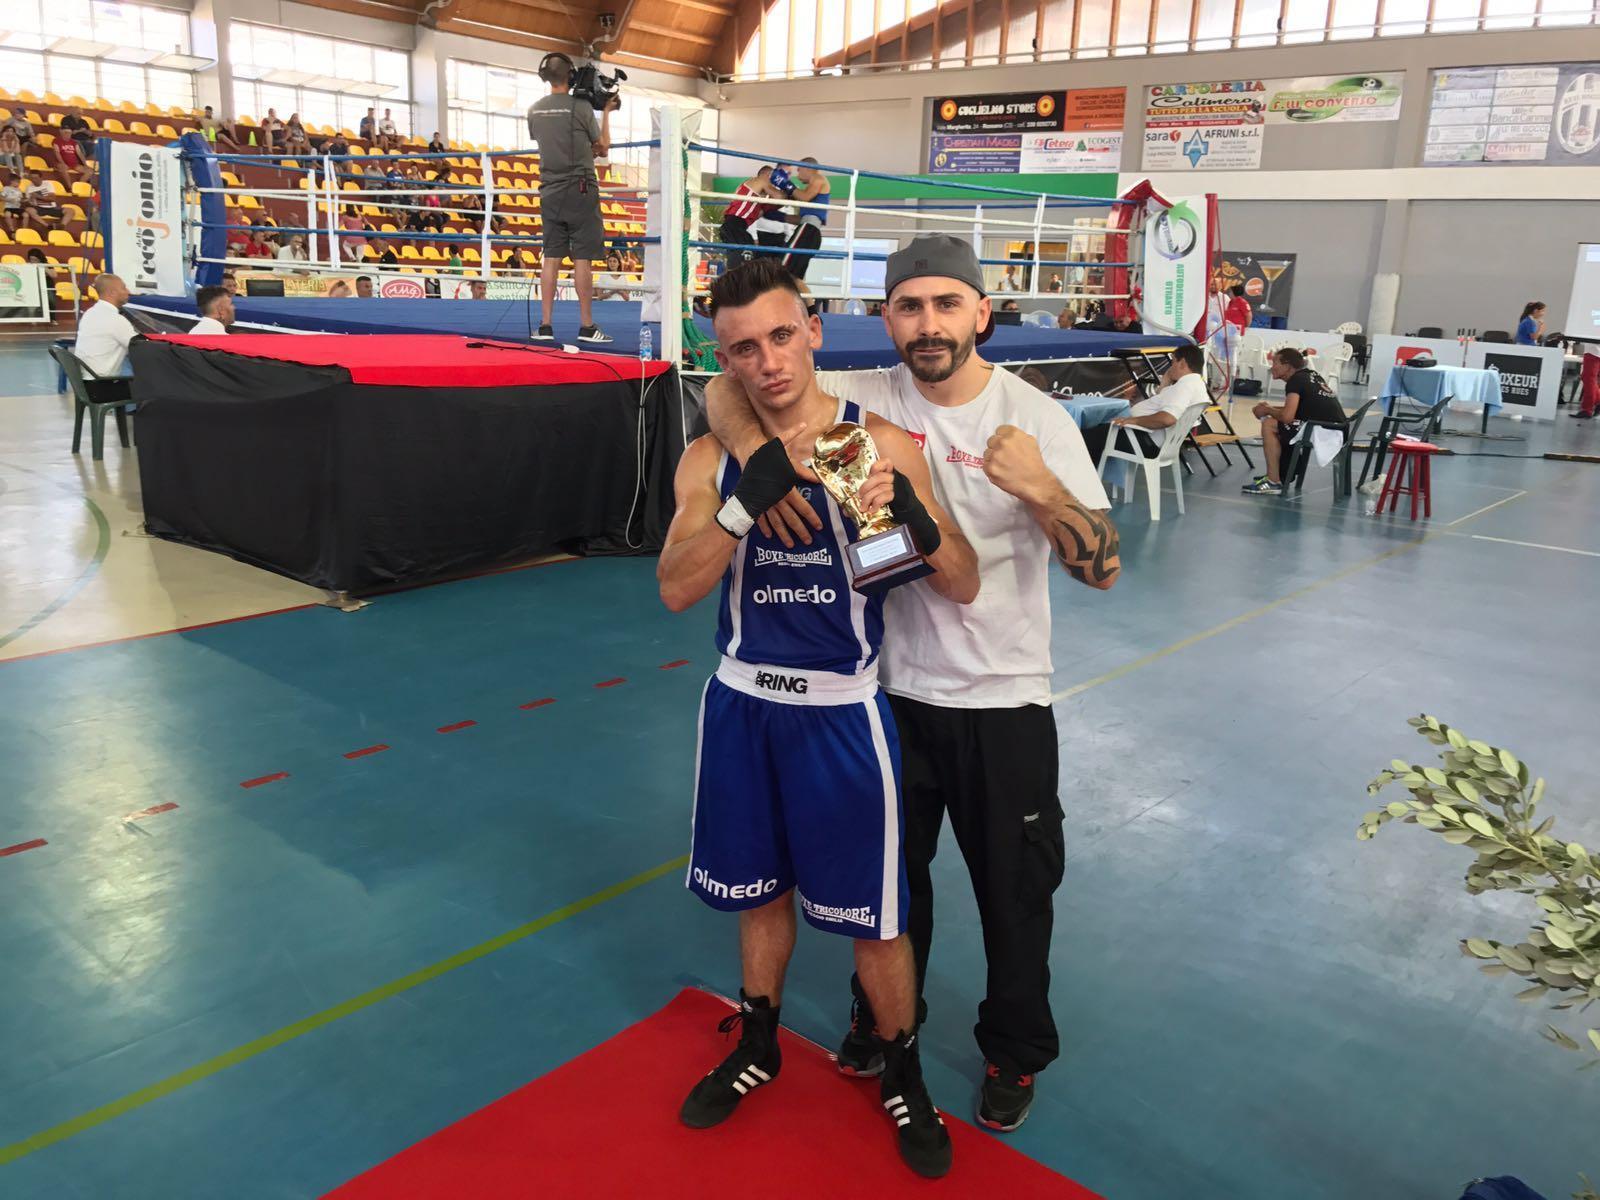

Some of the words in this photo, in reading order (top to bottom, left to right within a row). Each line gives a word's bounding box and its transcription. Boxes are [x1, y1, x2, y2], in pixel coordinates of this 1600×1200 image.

[1151, 80, 1266, 96] CARTOLERIA
[958, 104, 1005, 116] GUGLIELMO
[1006, 103, 1036, 114] STORE
[1151, 96, 1252, 108] Calimero
[1145, 132, 1169, 142] sara
[1204, 129, 1239, 139] AFRUNI
[1241, 128, 1260, 137] s.r.l.
[1164, 281, 1173, 315] OTRANTO
[1500, 373, 1538, 388] OXEUR
[756, 546, 784, 562] BOXE
[753, 584, 837, 604] olmedo
[762, 672, 808, 694] RING
[694, 867, 778, 899] olmedo
[813, 903, 870, 923] TRICOLORE
